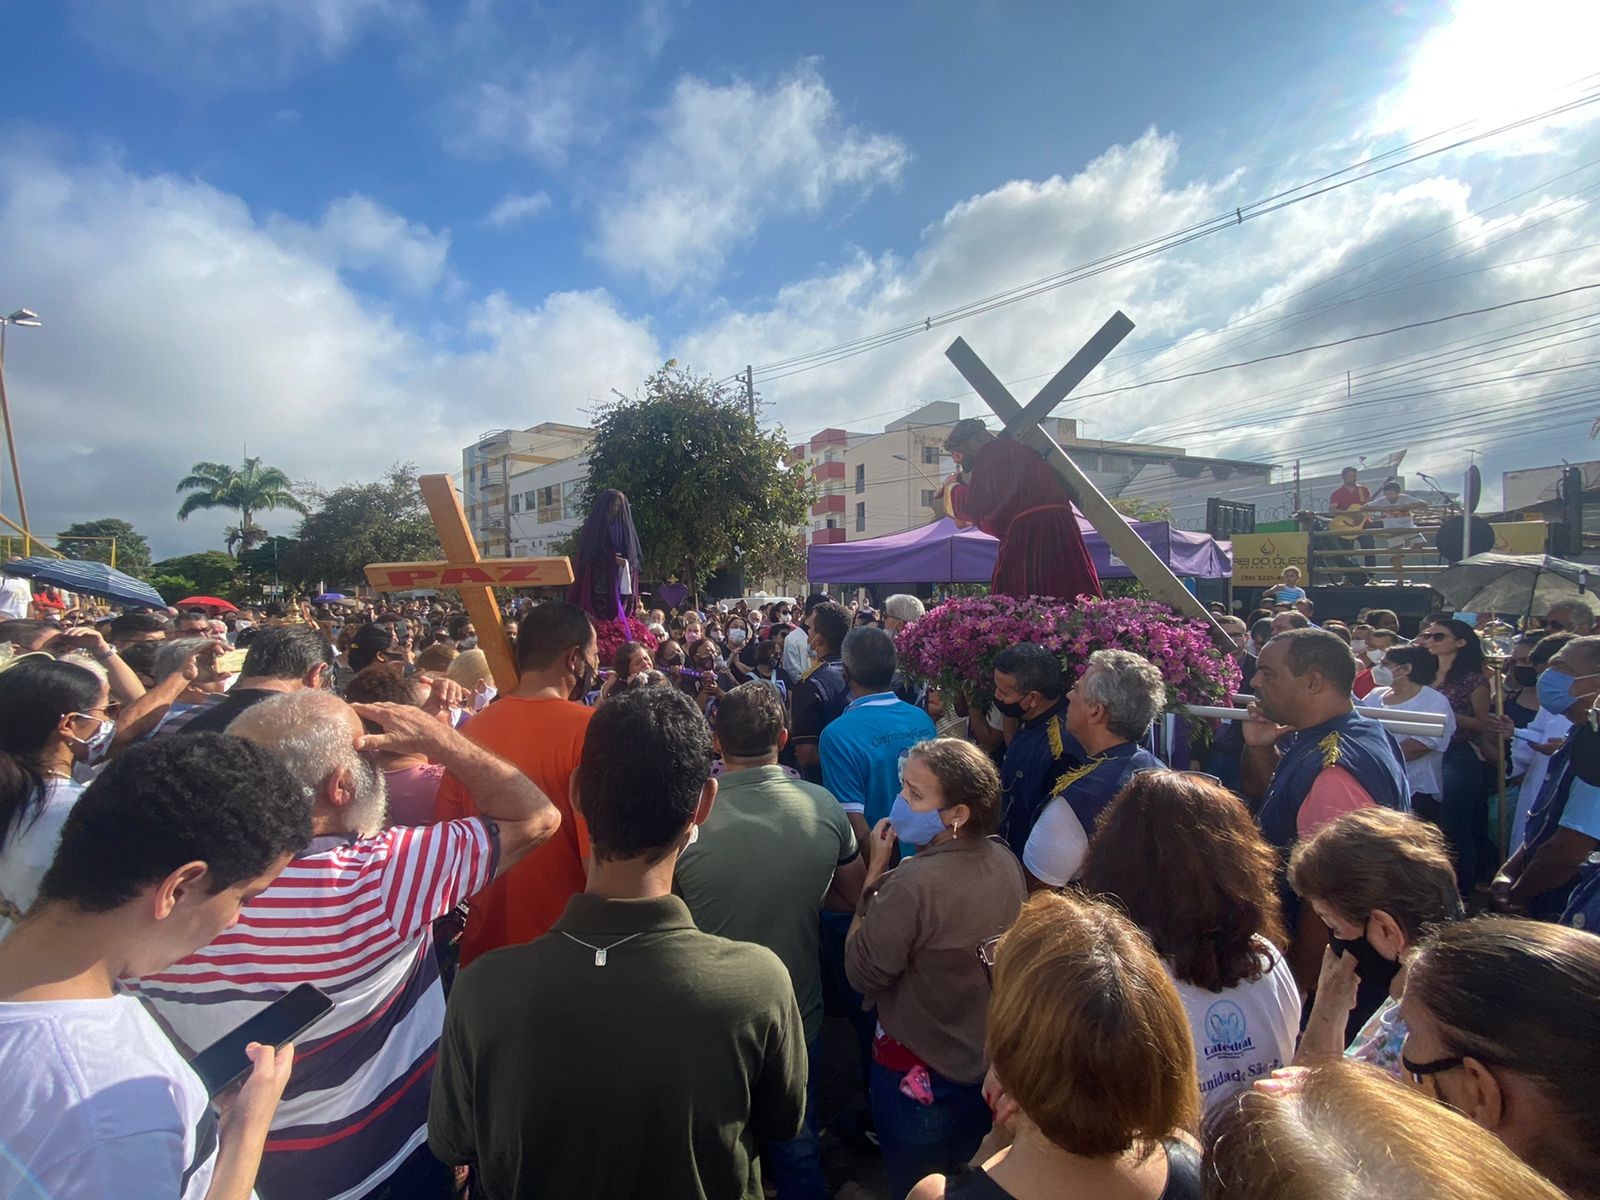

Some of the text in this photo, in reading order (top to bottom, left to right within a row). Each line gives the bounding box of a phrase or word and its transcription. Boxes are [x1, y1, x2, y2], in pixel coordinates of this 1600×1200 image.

[1252, 557, 1270, 565] DO
[386, 566, 542, 587] PAZ
[1204, 1037, 1252, 1056] Catedral
[1198, 1069, 1247, 1093] unidade
